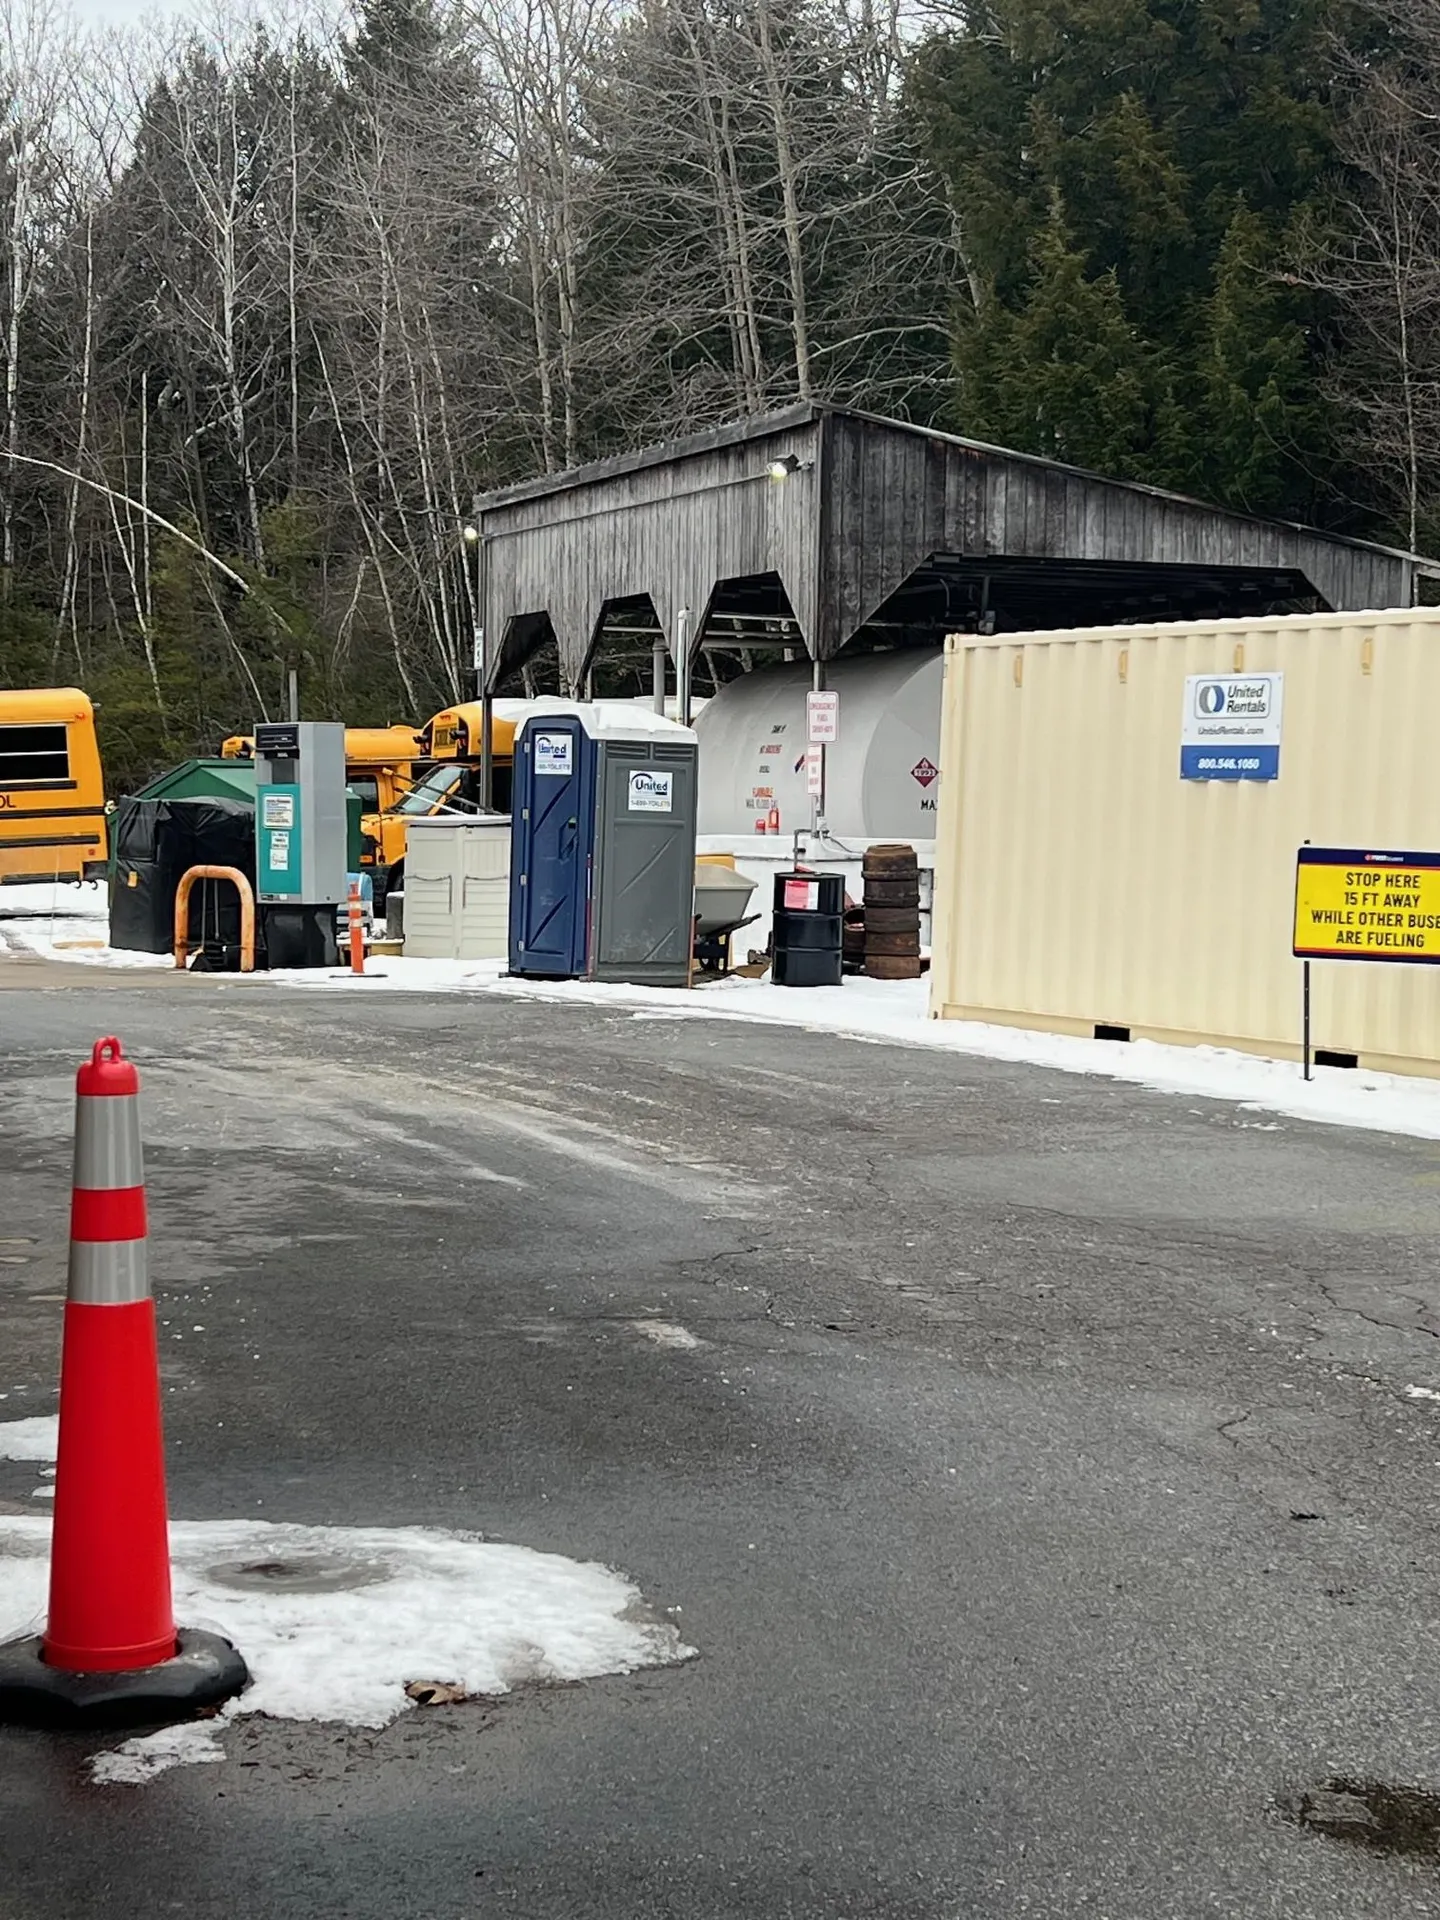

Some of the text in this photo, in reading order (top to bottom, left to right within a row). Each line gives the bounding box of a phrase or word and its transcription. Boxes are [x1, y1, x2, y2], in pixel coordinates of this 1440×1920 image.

[1228, 684, 1265, 698] United
[1227, 700, 1266, 713] Rentals
[539, 743, 567, 754] United
[635, 779, 668, 791] United
[1346, 872, 1421, 888] STOP HERE
[1344, 892, 1421, 908] 15 FT AWAY
[1311, 910, 1354, 925] WHILE
[1358, 912, 1403, 927] OTHER
[1335, 931, 1425, 948] ARE FUELING
